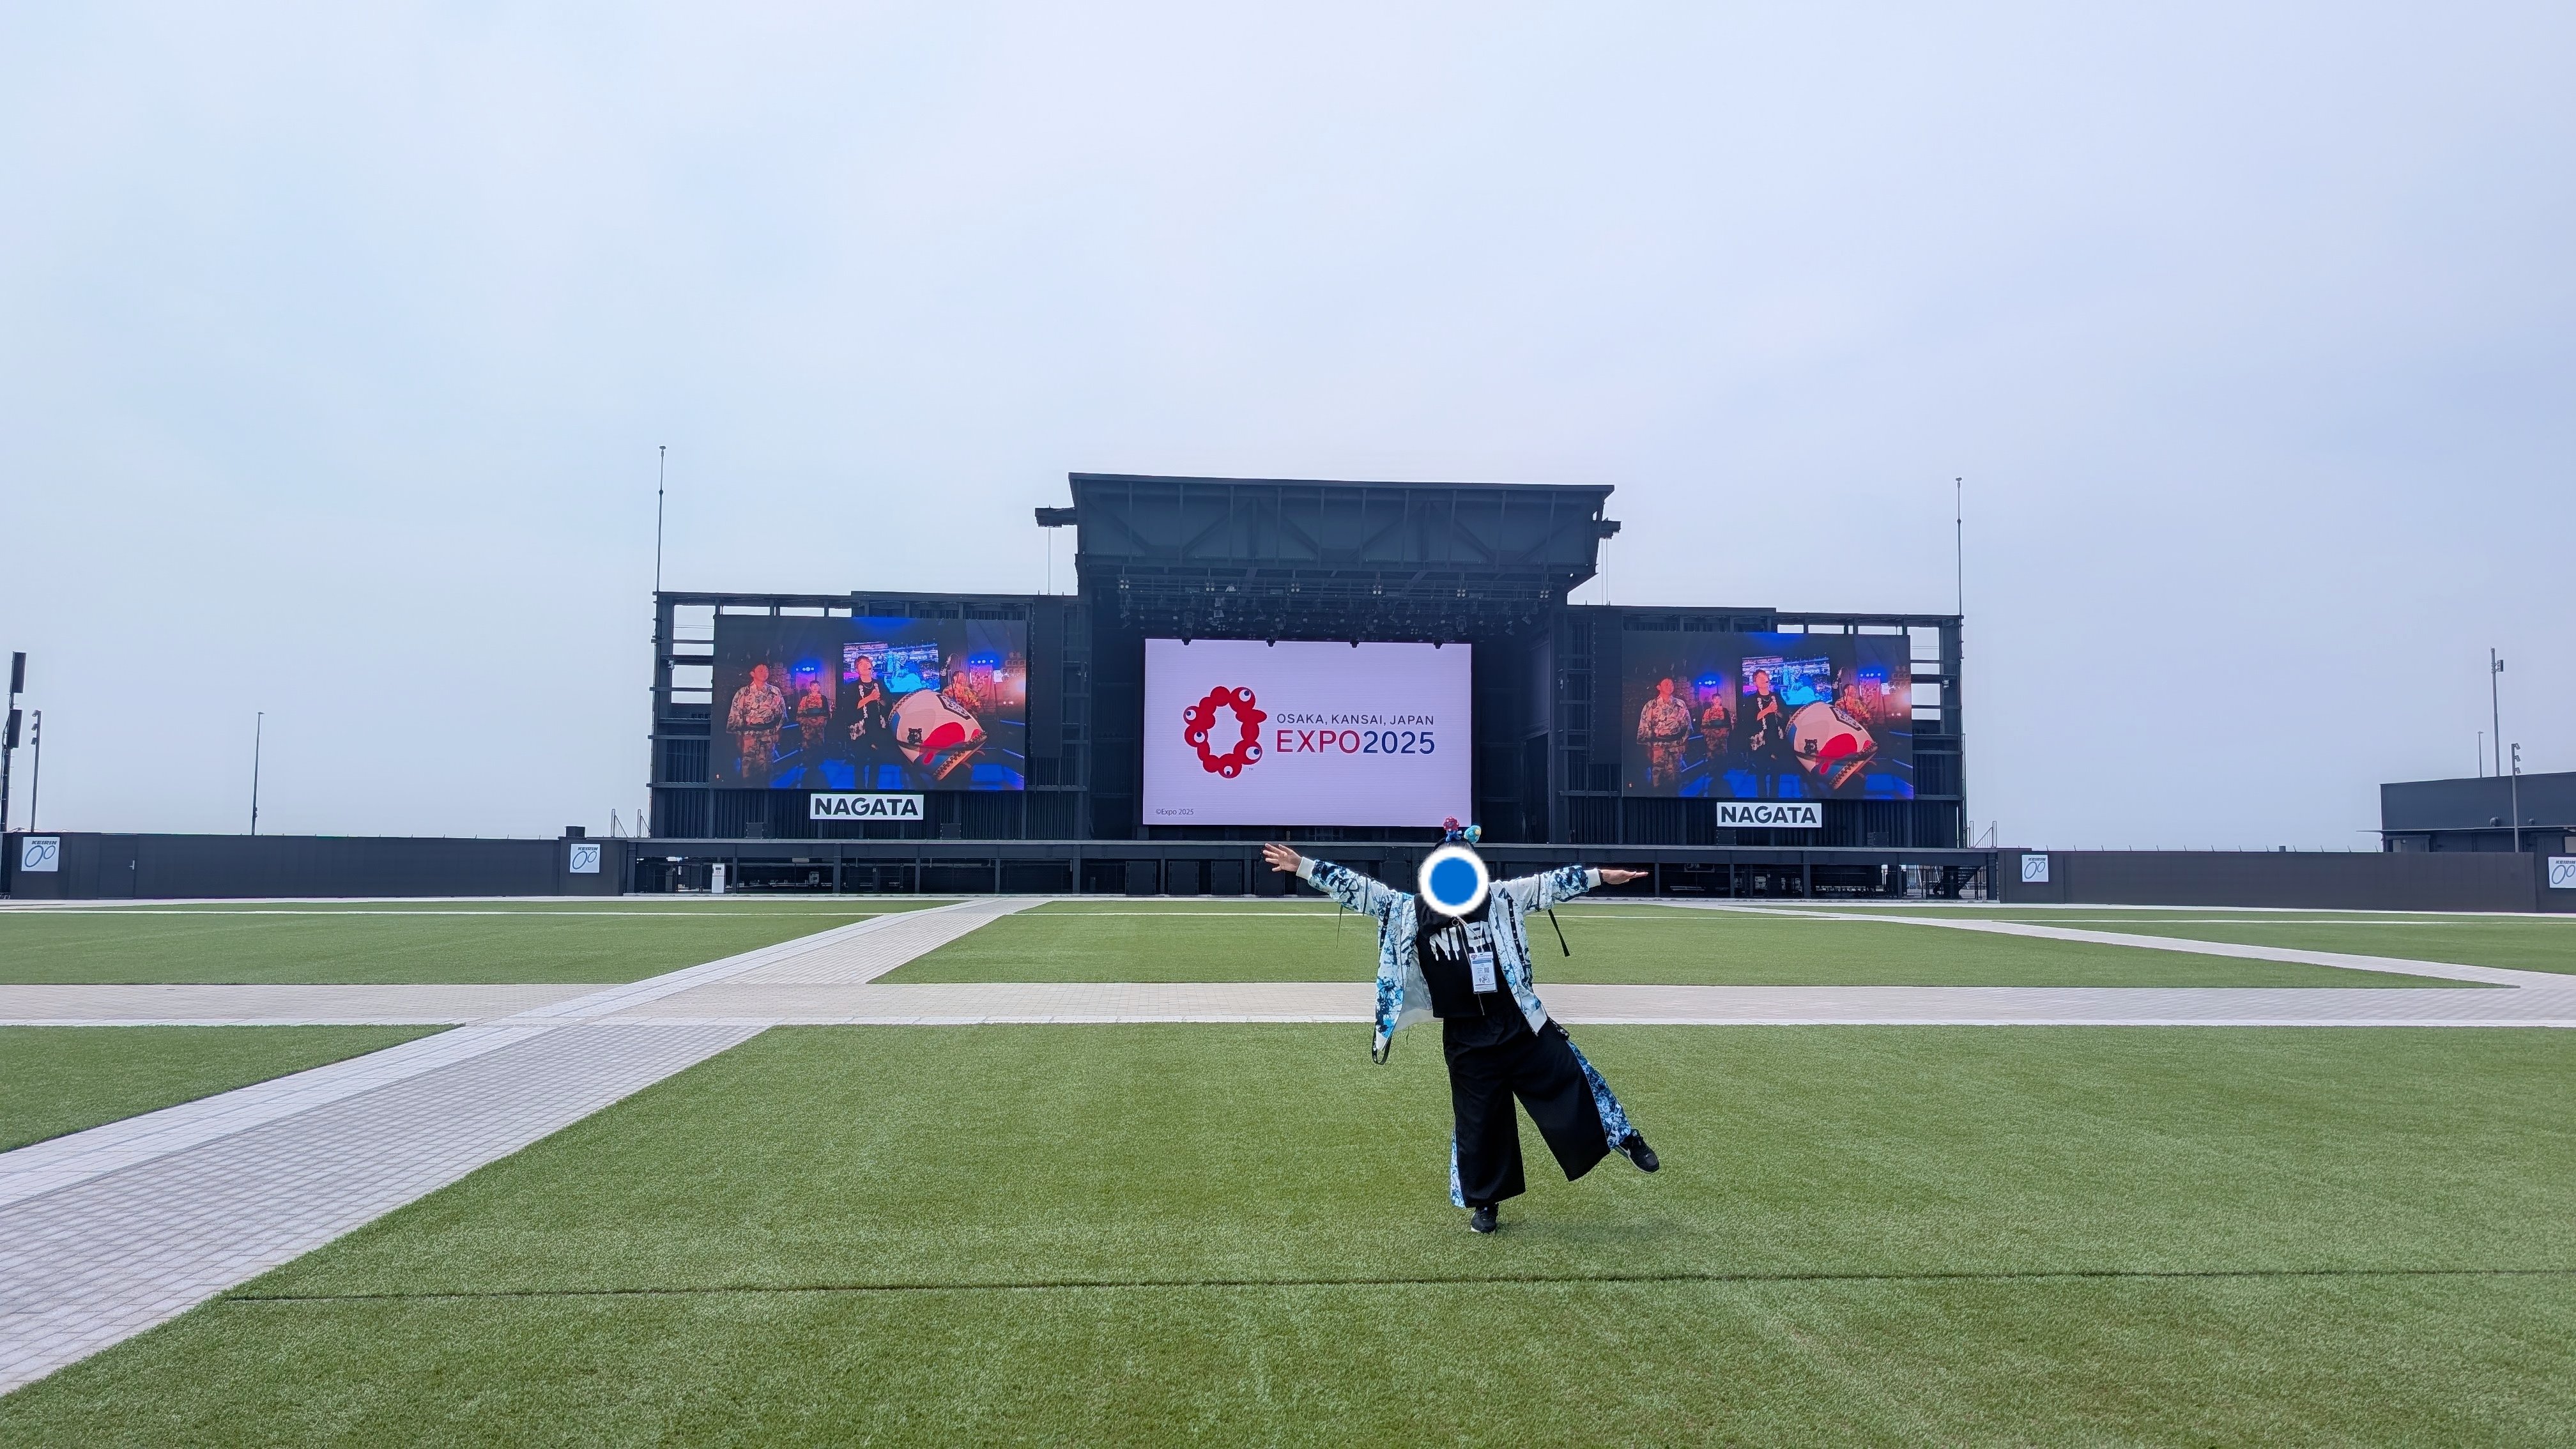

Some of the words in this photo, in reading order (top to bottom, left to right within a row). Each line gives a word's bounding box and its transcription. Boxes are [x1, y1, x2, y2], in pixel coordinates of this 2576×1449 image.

[1276, 713, 1328, 726] OSAKA,
[1331, 714, 1386, 726] KANSAI,
[1390, 715, 1434, 726] JAPAN
[1276, 730, 1436, 755] EXPO2025
[815, 797, 919, 816] NAGATA
[1721, 806, 1818, 824] NAGATA
